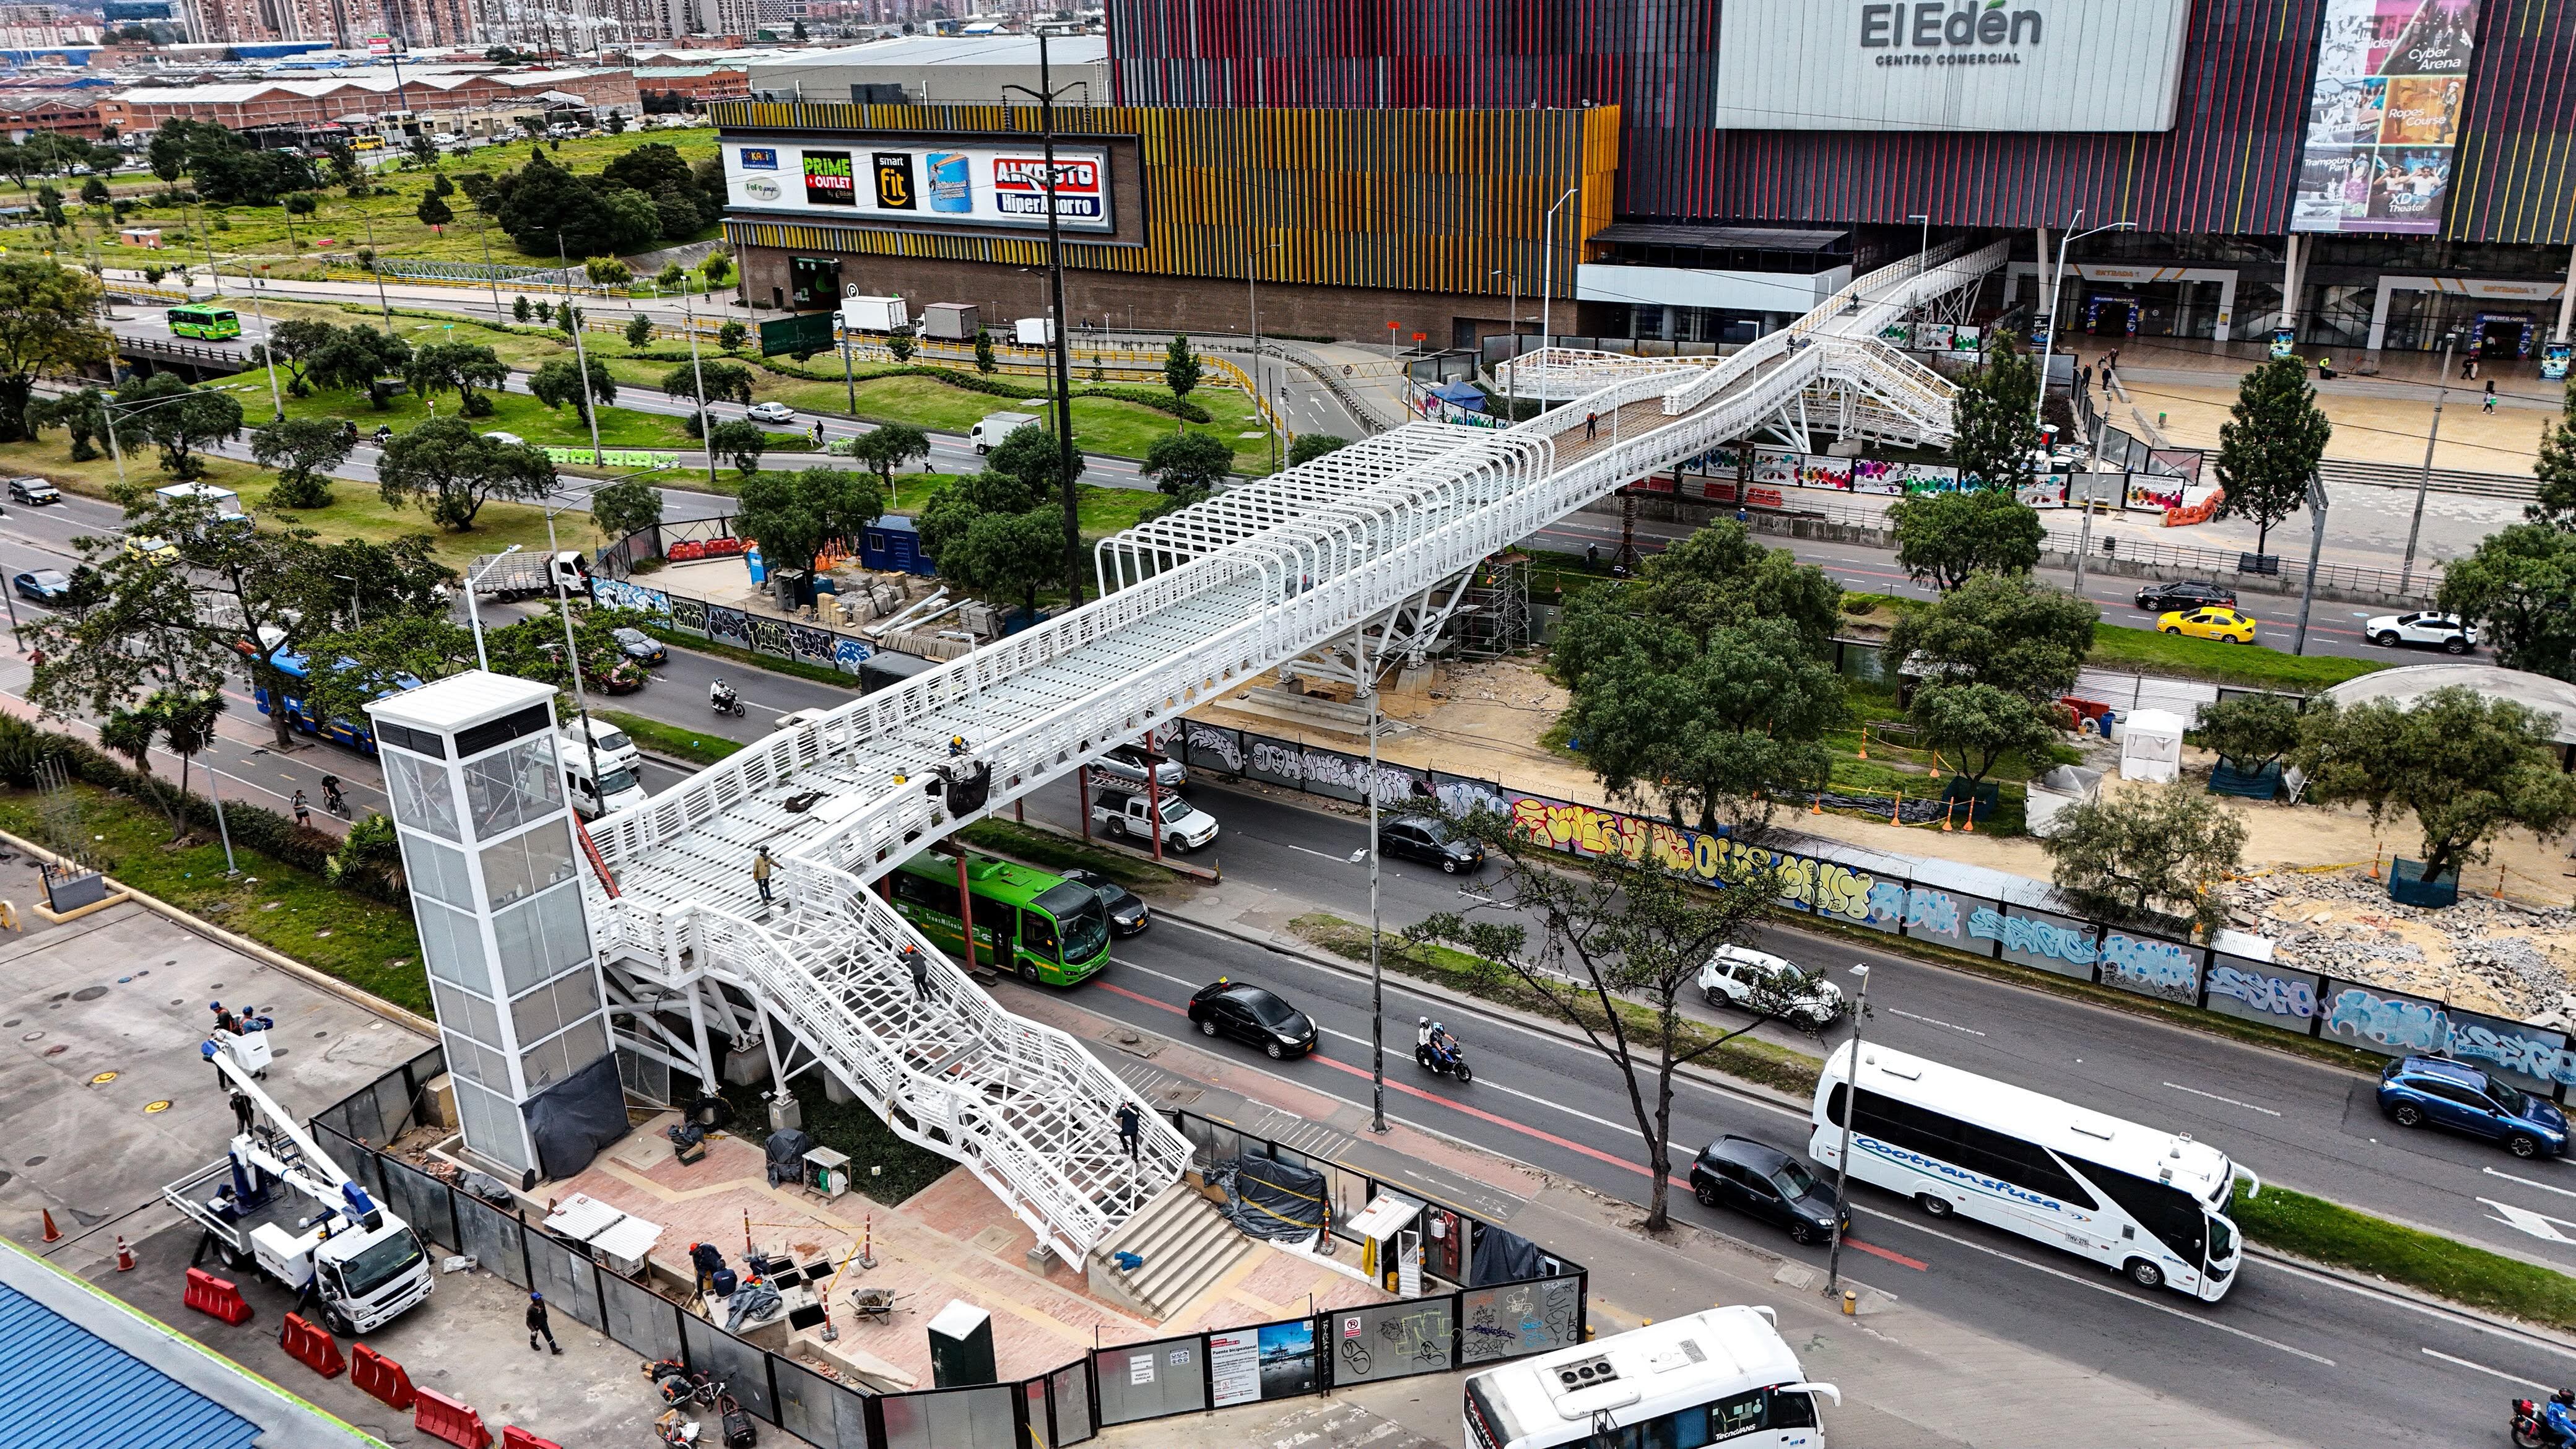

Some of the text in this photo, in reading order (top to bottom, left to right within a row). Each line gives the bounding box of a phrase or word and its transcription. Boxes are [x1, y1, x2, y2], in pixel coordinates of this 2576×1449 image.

[1912, 0, 2042, 45] Edén
[1875, 53, 2021, 66] CENTRO COMERCIAL
[2408, 47, 2450, 61] Cyber
[2418, 58, 2461, 70] Arena
[2388, 108, 2426, 120] Ropes
[2406, 116, 2446, 126] Course
[803, 157, 851, 176] PRIME
[879, 157, 903, 166] smart
[2304, 156, 2354, 168] Trampoline
[2328, 163, 2349, 172] Park
[815, 176, 851, 189] OUTLET
[881, 168, 906, 197] fit
[1001, 193, 1092, 215] HiperAorro
[2389, 193, 2413, 205] XD
[2388, 204, 2426, 213] Theater
[925, 913, 962, 930] TransMilenio
[1856, 1137, 2061, 1212] Cootransfusa
[2066, 1233, 2089, 1247] THV-275
[1229, 1344, 1256, 1352] bicipeatonal
[1469, 1399, 1497, 1449] Bolivarian
